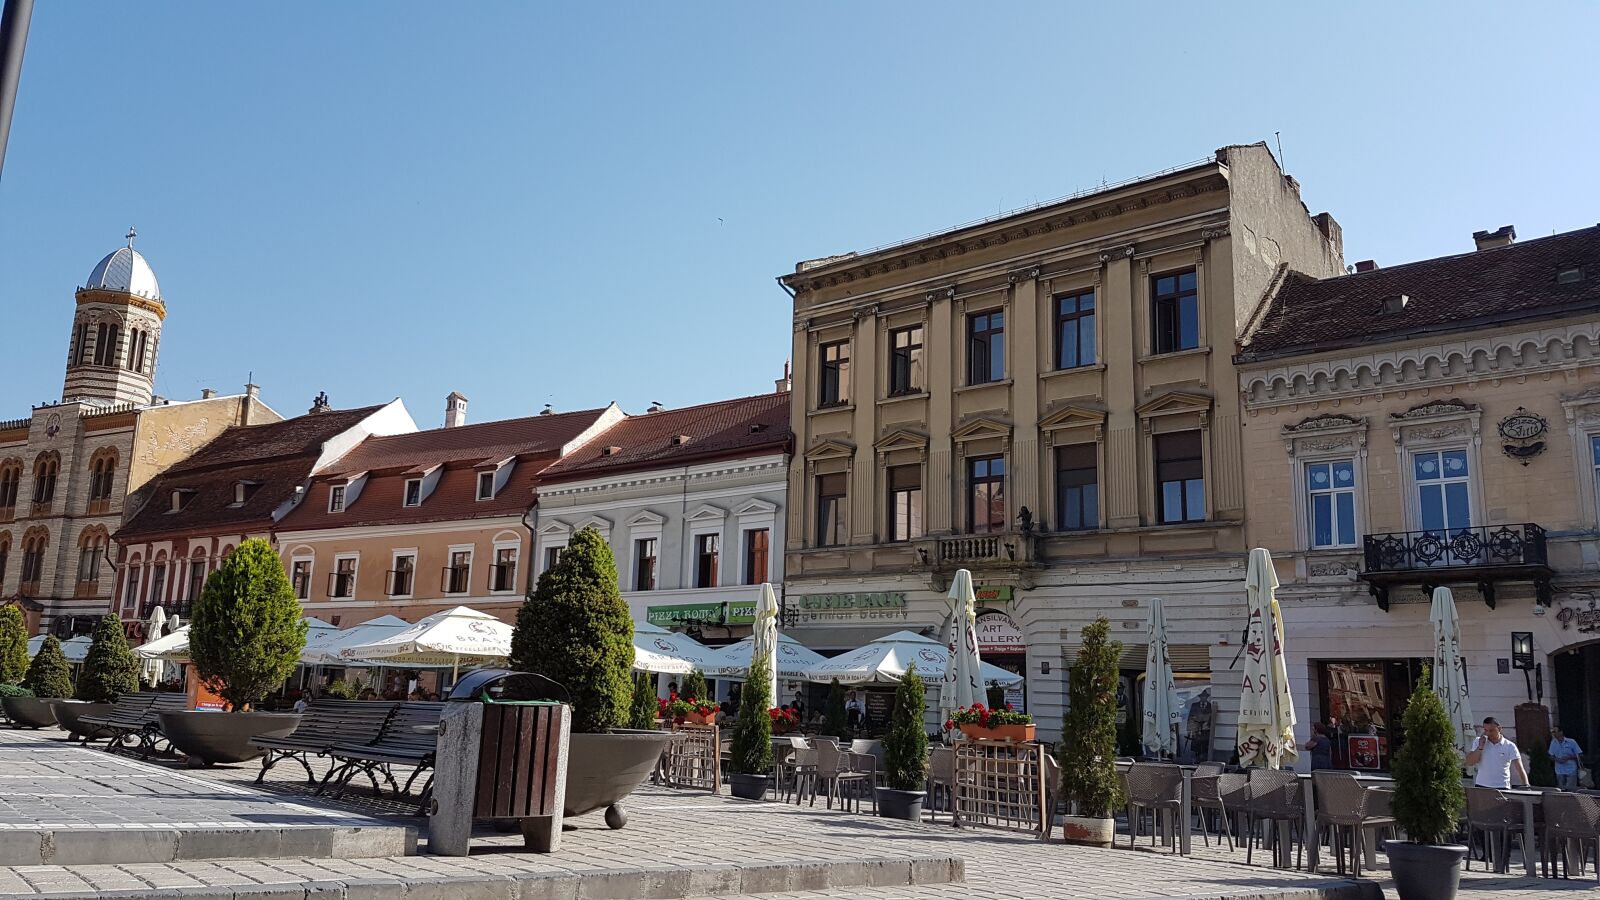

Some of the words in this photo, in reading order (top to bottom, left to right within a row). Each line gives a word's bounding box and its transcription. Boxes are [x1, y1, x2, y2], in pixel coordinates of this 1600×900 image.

[648, 610, 679, 621] PIZZA
[732, 606, 758, 617] PIZZ
[802, 612, 852, 622] german
[860, 609, 908, 620] bakery
[976, 615, 1020, 632] ANSILVANIA
[982, 624, 1002, 633] ART
[126, 621, 142, 638] FC
[977, 635, 1022, 643] ALLERY
